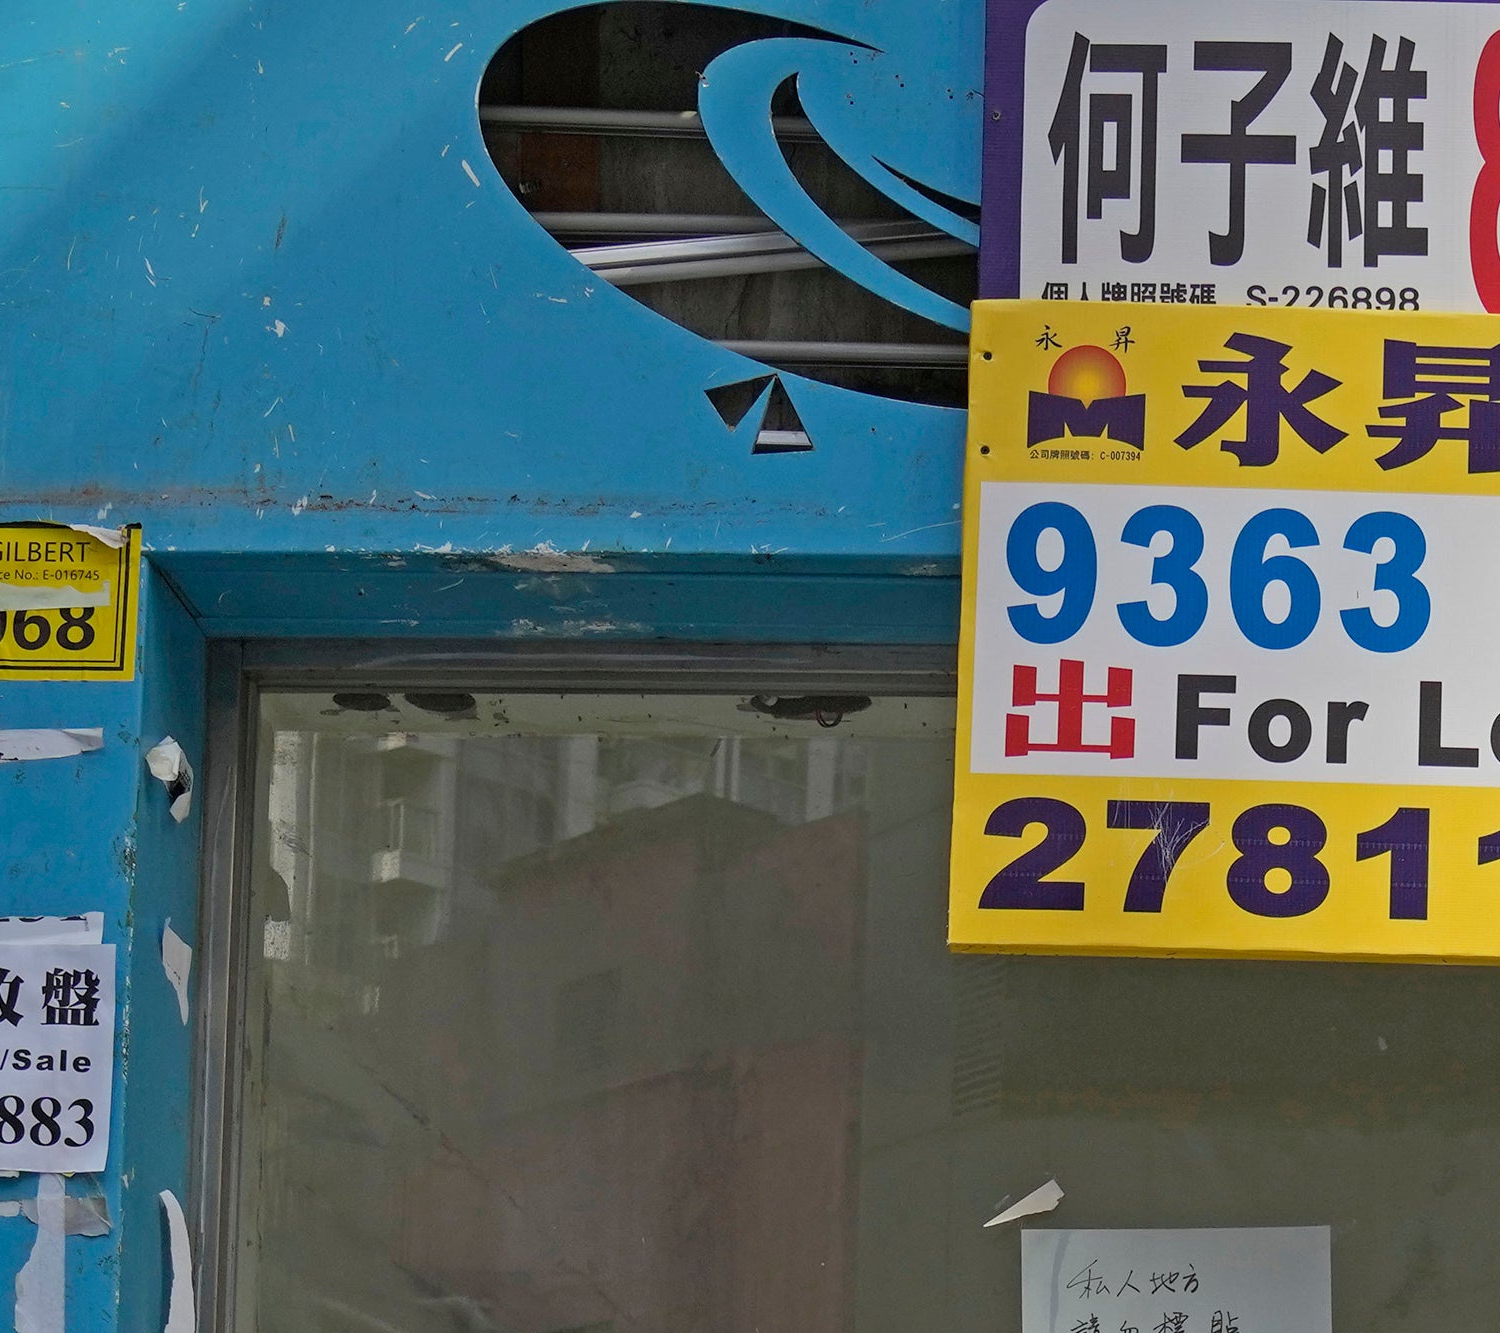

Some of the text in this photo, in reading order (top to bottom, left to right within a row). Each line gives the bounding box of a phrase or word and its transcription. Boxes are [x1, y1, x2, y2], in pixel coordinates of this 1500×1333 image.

[1047, 31, 1429, 268] 何子維
[1246, 284, 1421, 312] S-226898
[1099, 450, 1142, 462] C-007394
[13, 568, 40, 581] No.:
[42, 569, 101, 582] E-016745
[1005, 500, 1431, 655] 9363
[1004, 658, 1137, 761] 出
[1174, 671, 1370, 766] For
